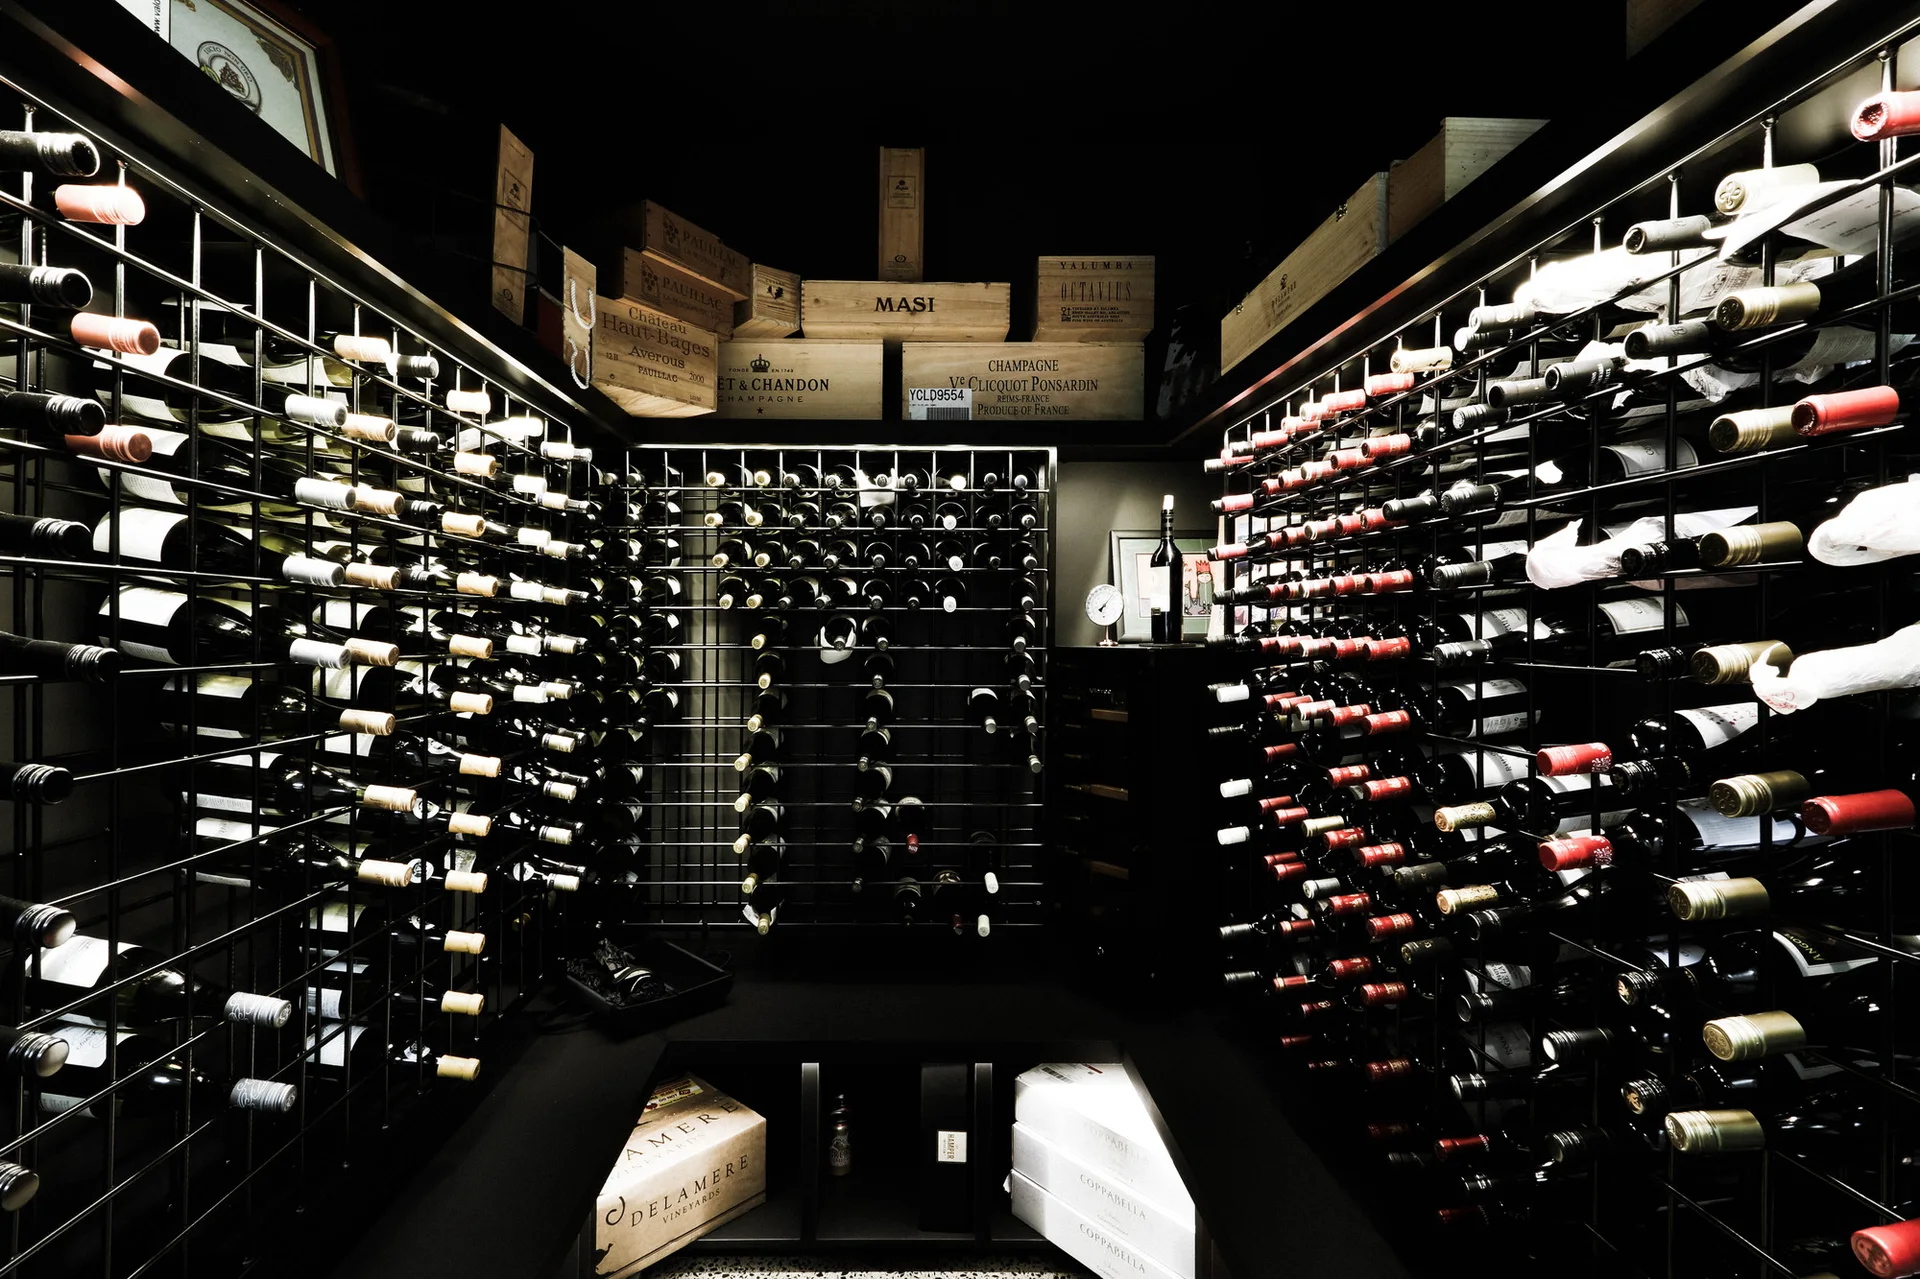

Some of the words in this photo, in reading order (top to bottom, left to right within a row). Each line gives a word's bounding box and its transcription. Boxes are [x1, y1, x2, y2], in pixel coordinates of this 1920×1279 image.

[662, 279, 723, 312] PAUILLAC
[1061, 281, 1131, 301] OCTAVIUS
[875, 297, 935, 313] MASI
[628, 306, 688, 335] Château
[601, 311, 711, 358] Haut-Bages
[627, 345, 686, 370] Averous
[988, 359, 1060, 373] CHAMPAGNE
[638, 365, 679, 384] PAUILLAC
[689, 372, 705, 384] 2000
[739, 379, 748, 392] &
[751, 378, 829, 392] CHANDON
[968, 376, 1028, 395] CLICQUOT
[1031, 376, 1098, 393] PONSARDIN
[909, 389, 965, 401] YCLD9554
[977, 404, 1022, 416] PRODUCE
[1023, 404, 1034, 416] OF
[1034, 403, 1070, 416] FRANCE
[613, 1101, 738, 1168] AMERE
[631, 1154, 749, 1228] DELAMERE
[1079, 1173, 1147, 1221] COPPABELLA
[662, 1187, 722, 1224] VINEYARDS
[1079, 1222, 1146, 1275] COPPABELLA
